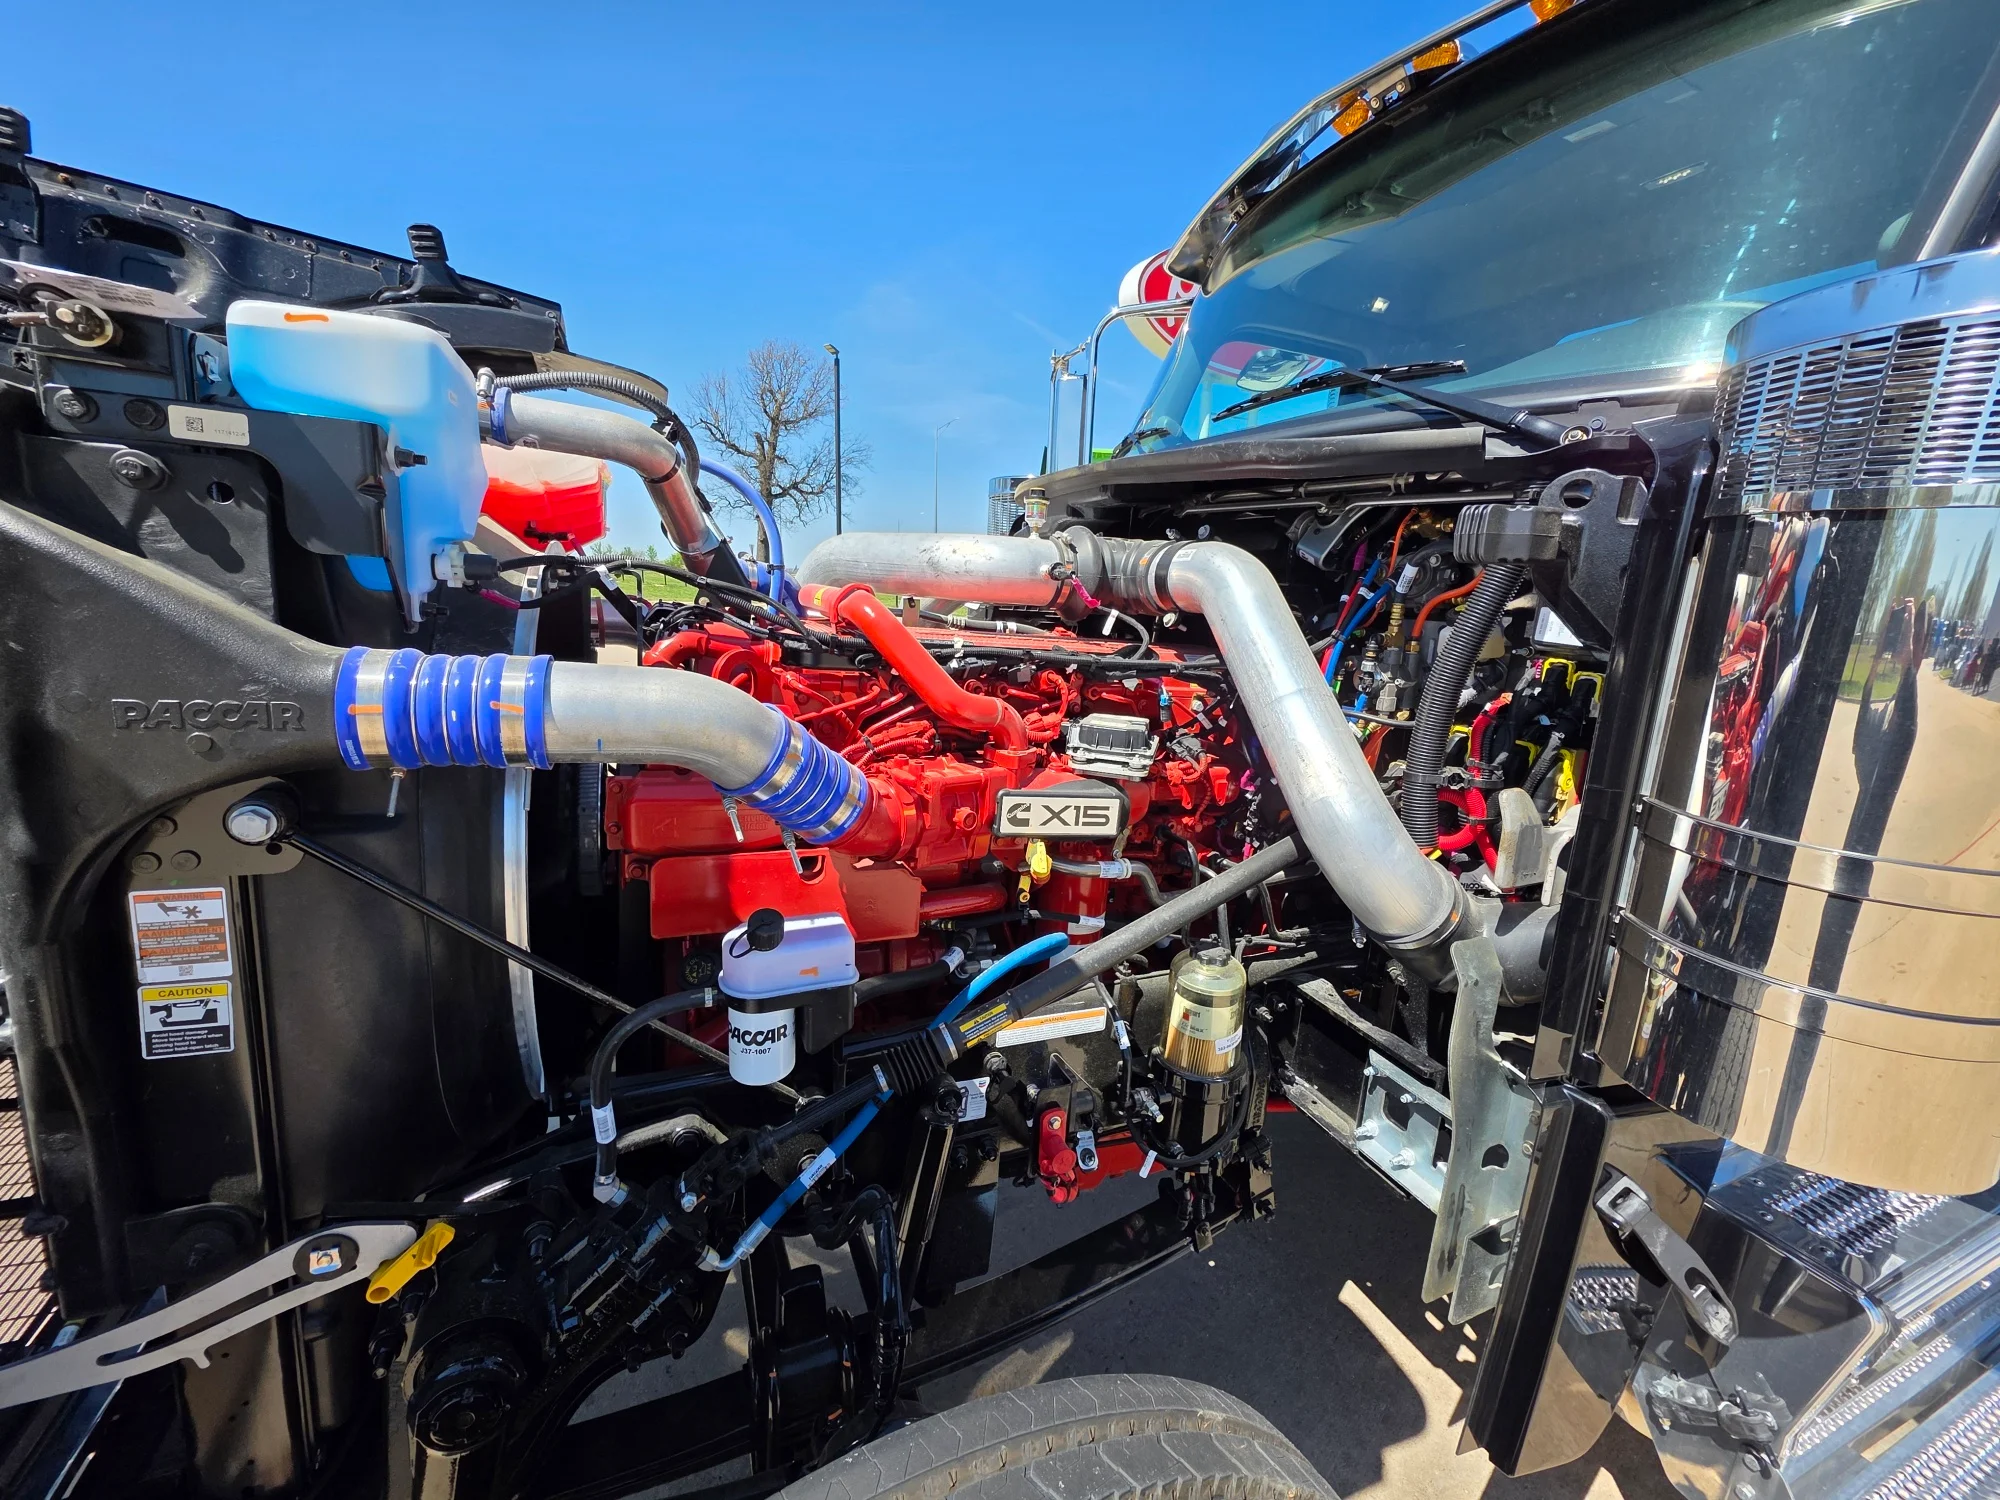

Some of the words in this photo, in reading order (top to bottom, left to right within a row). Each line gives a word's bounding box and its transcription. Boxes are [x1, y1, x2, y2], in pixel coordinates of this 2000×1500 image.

[111, 698, 306, 732] PACCAR
[1039, 804, 1110, 827] X15
[162, 892, 205, 902] WARNING
[158, 987, 213, 998] CAUTION
[741, 1047, 771, 1055] J37-1007
